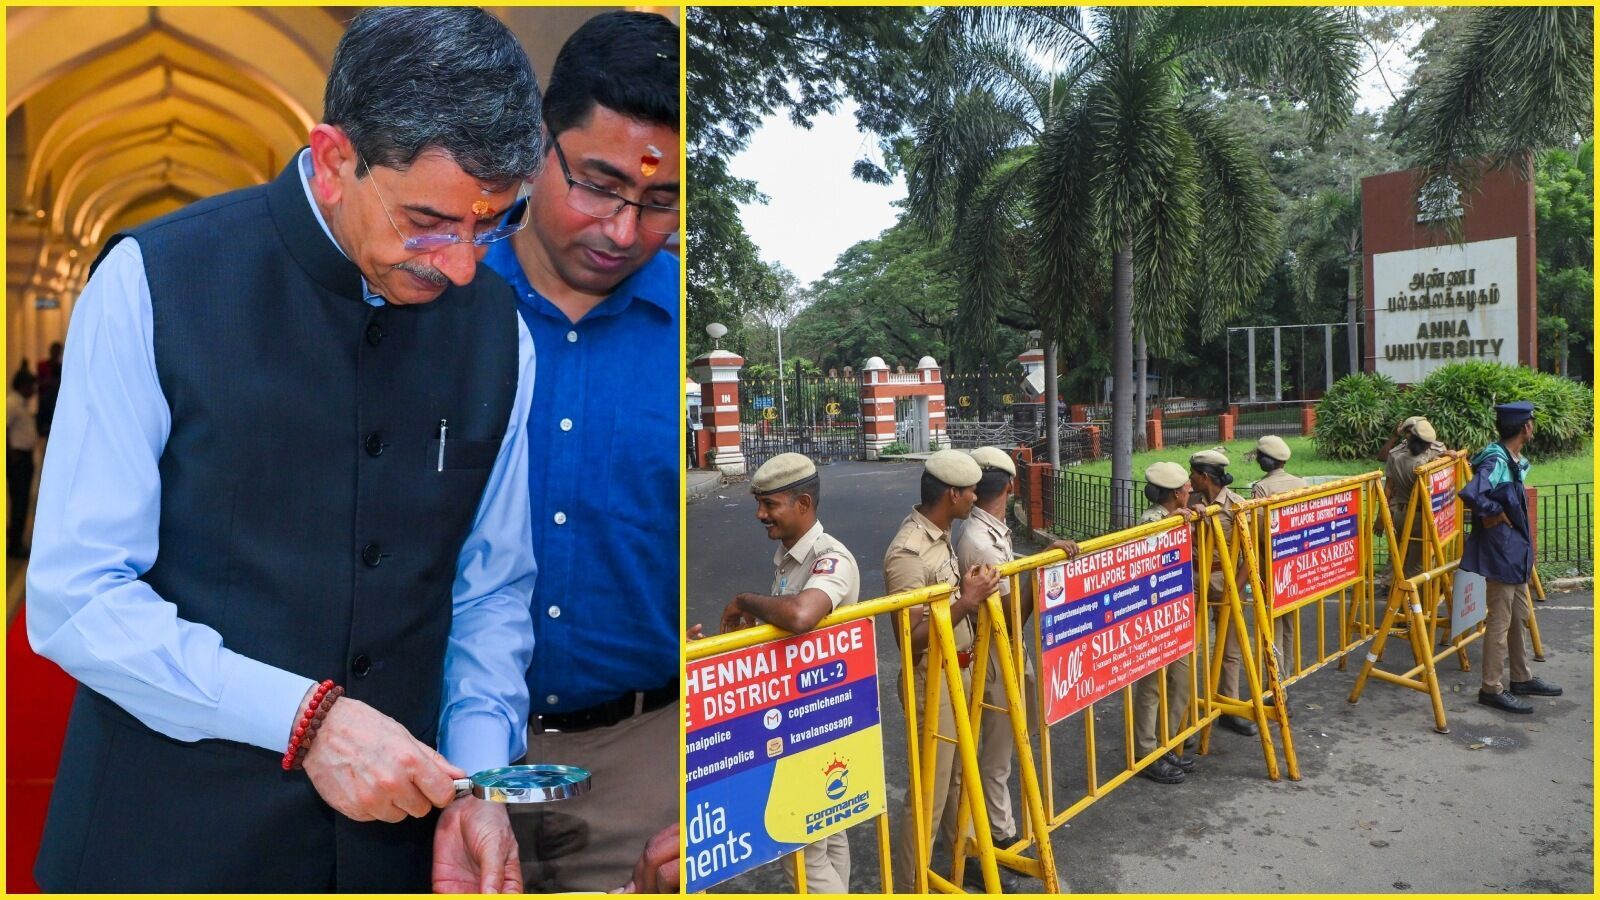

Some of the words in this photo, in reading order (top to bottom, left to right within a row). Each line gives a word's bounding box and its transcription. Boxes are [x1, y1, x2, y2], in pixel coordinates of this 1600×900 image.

[1409, 267, 1476, 291] அண்ணா
[1417, 319, 1471, 340] ANNA
[1385, 338, 1504, 361] UNIVERSITY
[721, 394, 731, 403] IN
[1281, 502, 1308, 516] GREATER
[1309, 497, 1334, 510] CHENNAI
[1335, 491, 1352, 504] POLICE
[1291, 512, 1315, 528] MYLAPORE
[1316, 507, 1336, 521] DISTRICT
[1067, 553, 1114, 578] GREATER
[1117, 537, 1157, 563] CHENN
[1158, 529, 1187, 550] POLICE
[1296, 551, 1319, 573] SILK
[1320, 540, 1355, 563] SAREES
[1084, 565, 1126, 593] MYLAPORE
[1130, 554, 1161, 579] DISTRICT
[1092, 622, 1131, 661] SILK
[1134, 598, 1190, 640] SAREES
[785, 627, 863, 668] POLICE
[1048, 644, 1084, 715] Nalli
[1075, 676, 1095, 702] 100
[703, 675, 791, 721] DISTRICT
[790, 715, 853, 745] kavalansosapp
[686, 802, 726, 847] dia
[806, 790, 869, 824] Coromandel
[806, 802, 870, 835] KING
